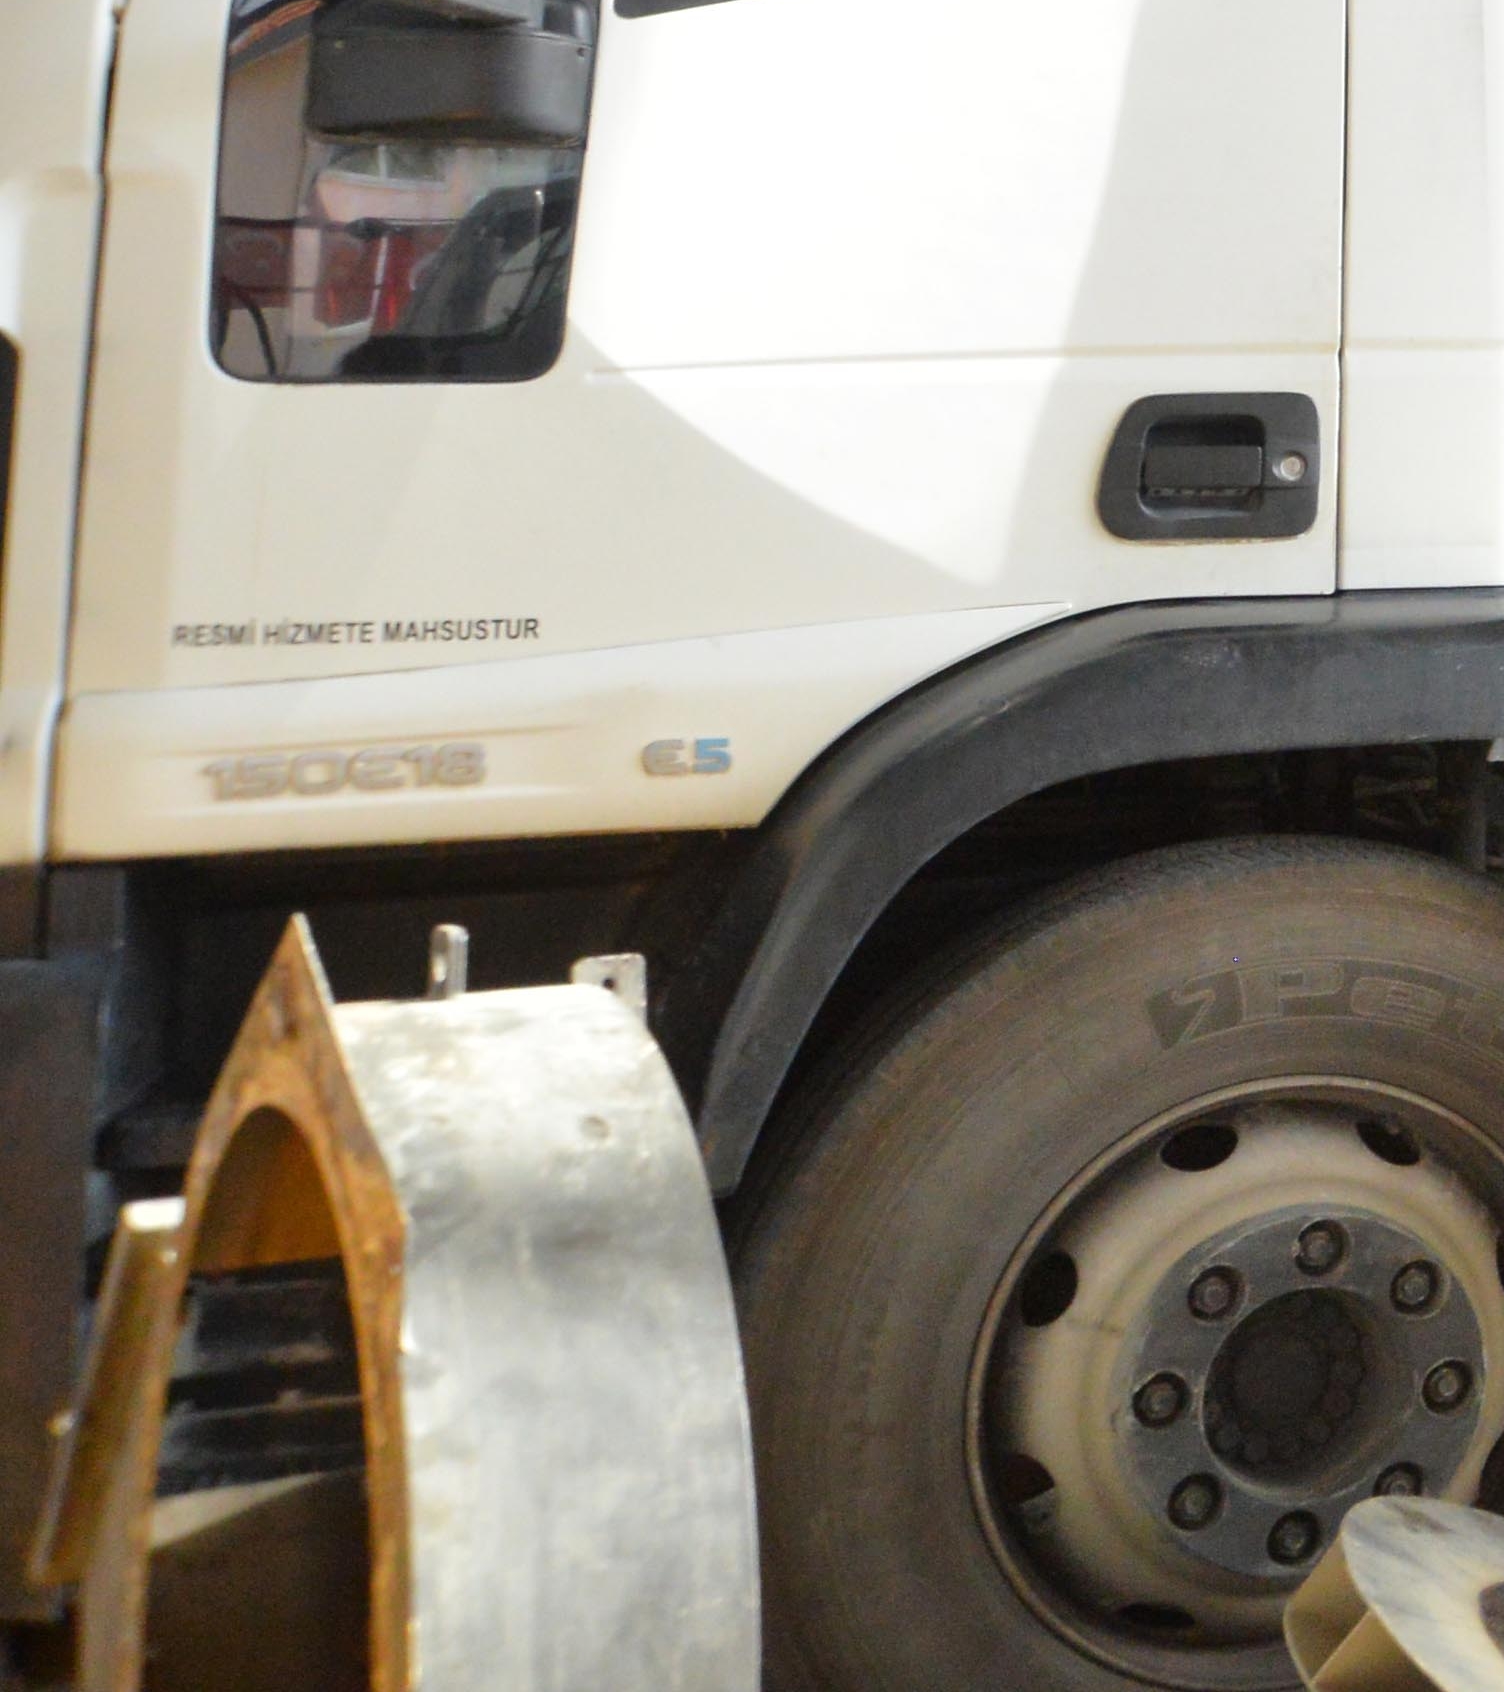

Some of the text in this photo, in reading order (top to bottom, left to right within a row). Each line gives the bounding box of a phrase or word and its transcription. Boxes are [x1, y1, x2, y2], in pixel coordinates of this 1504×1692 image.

[171, 616, 541, 648] RESMİ HİZMETE MAHSUSTUR
[197, 740, 489, 803] 150E18
